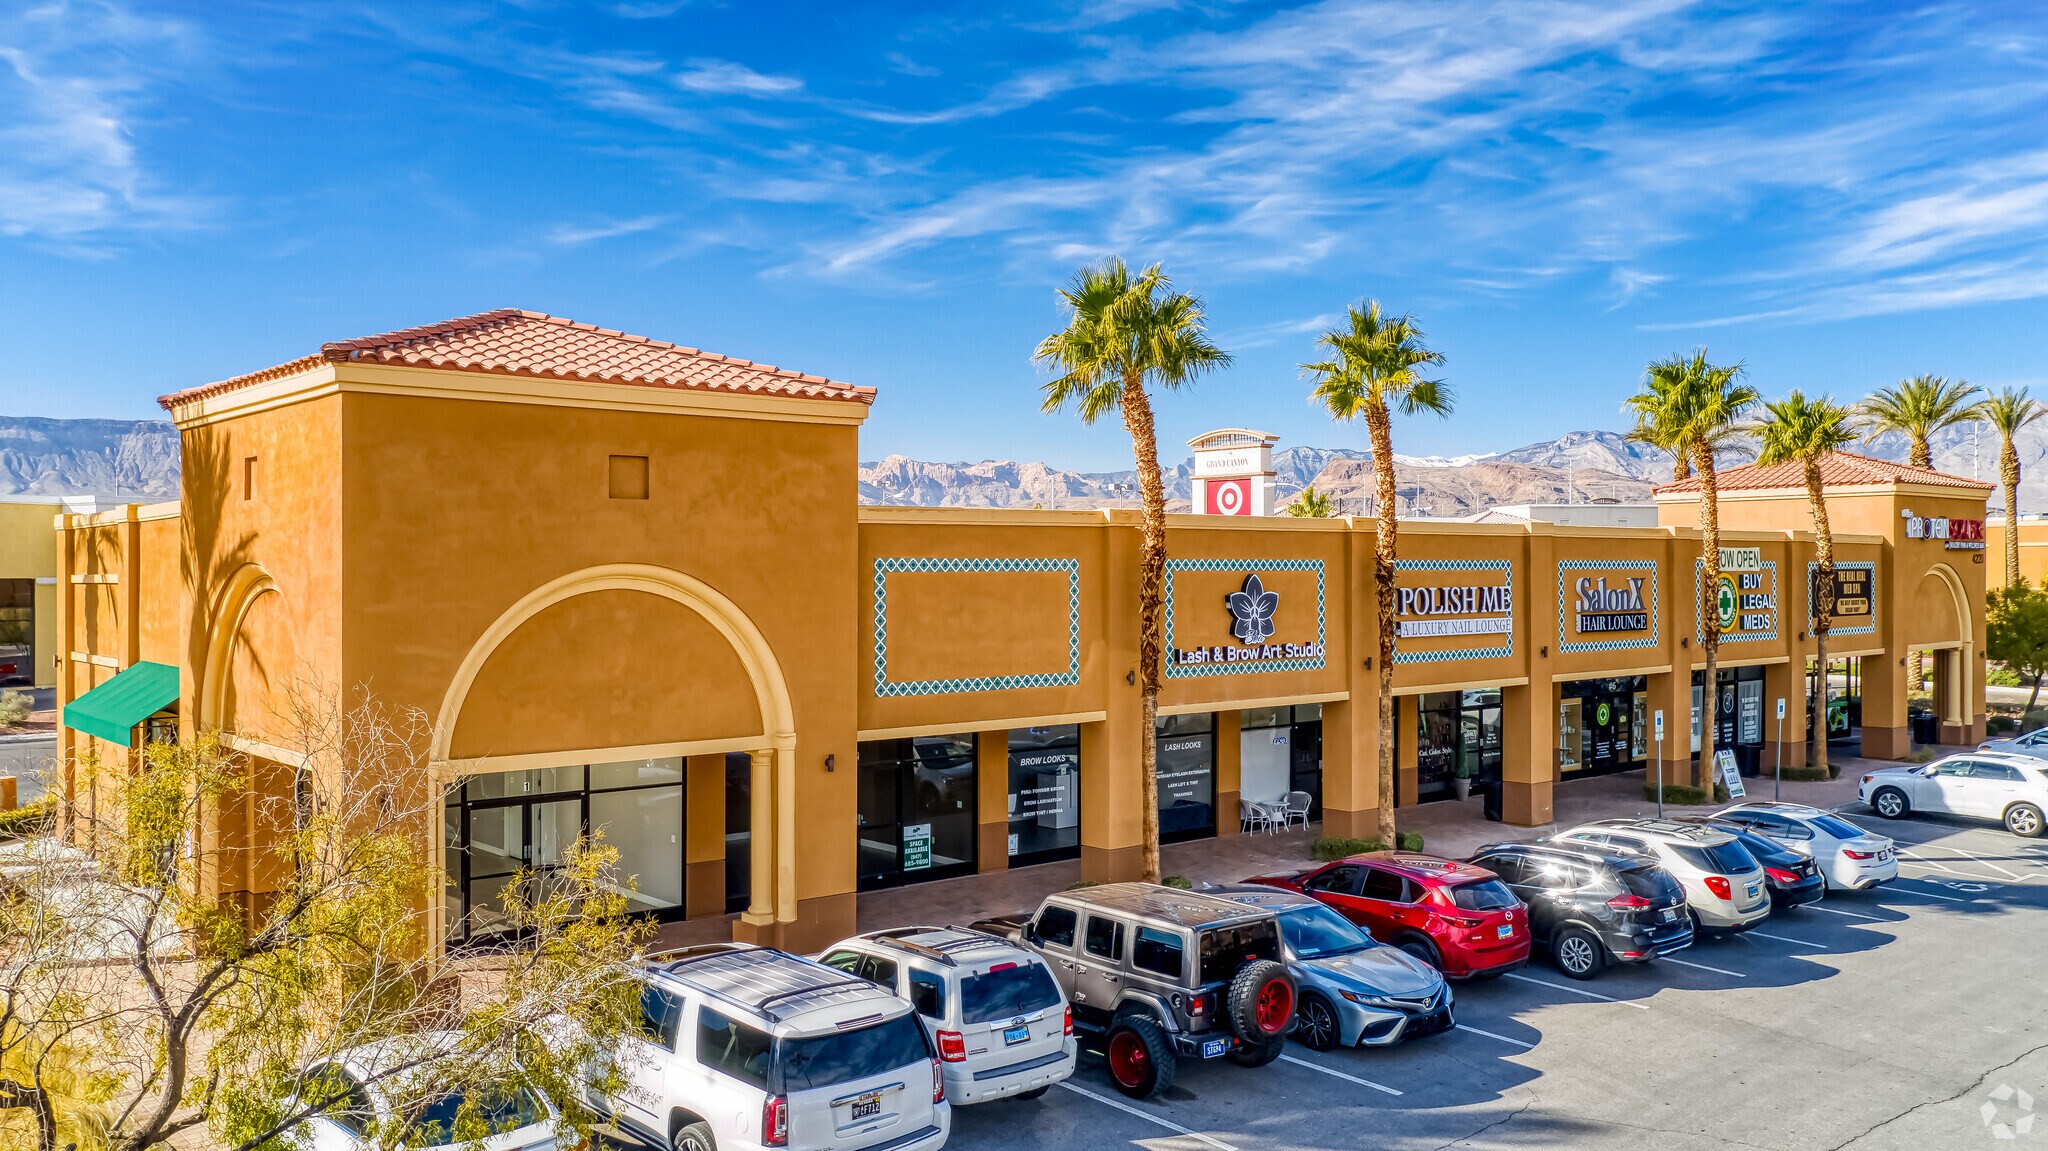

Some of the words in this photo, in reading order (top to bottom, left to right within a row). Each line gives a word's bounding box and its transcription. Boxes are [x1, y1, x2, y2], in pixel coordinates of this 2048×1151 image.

[1206, 459, 1225, 468] GRAND
[1226, 457, 1249, 467] CANYON
[1718, 550, 1735, 568] OW
[1737, 550, 1759, 568] OPEN
[1743, 573, 1763, 589] BUY
[1400, 586, 1479, 616] POLISH
[1481, 585, 1512, 613] ME
[1743, 593, 1775, 610] LEGAL
[1403, 623, 1410, 636] A
[1412, 621, 1450, 636] LUXURY
[1452, 620, 1474, 634] NAIL
[1476, 618, 1511, 633] LOUNGE
[1582, 615, 1607, 631] HAIR
[1608, 614, 1647, 630] LOUNGE
[1743, 613, 1771, 630] MEDS
[1179, 646, 1210, 665] Lash
[1213, 645, 1225, 662] &
[1227, 645, 1260, 662] Brow
[1261, 643, 1282, 660] Art
[1285, 641, 1324, 658] Studio
[1164, 743, 1181, 752] LASH
[1181, 741, 1202, 750] LOOKS
[1020, 756, 1042, 766] BROW
[1042, 754, 1066, 764] LOOKS
[904, 846, 928, 854] AVAILABLE
